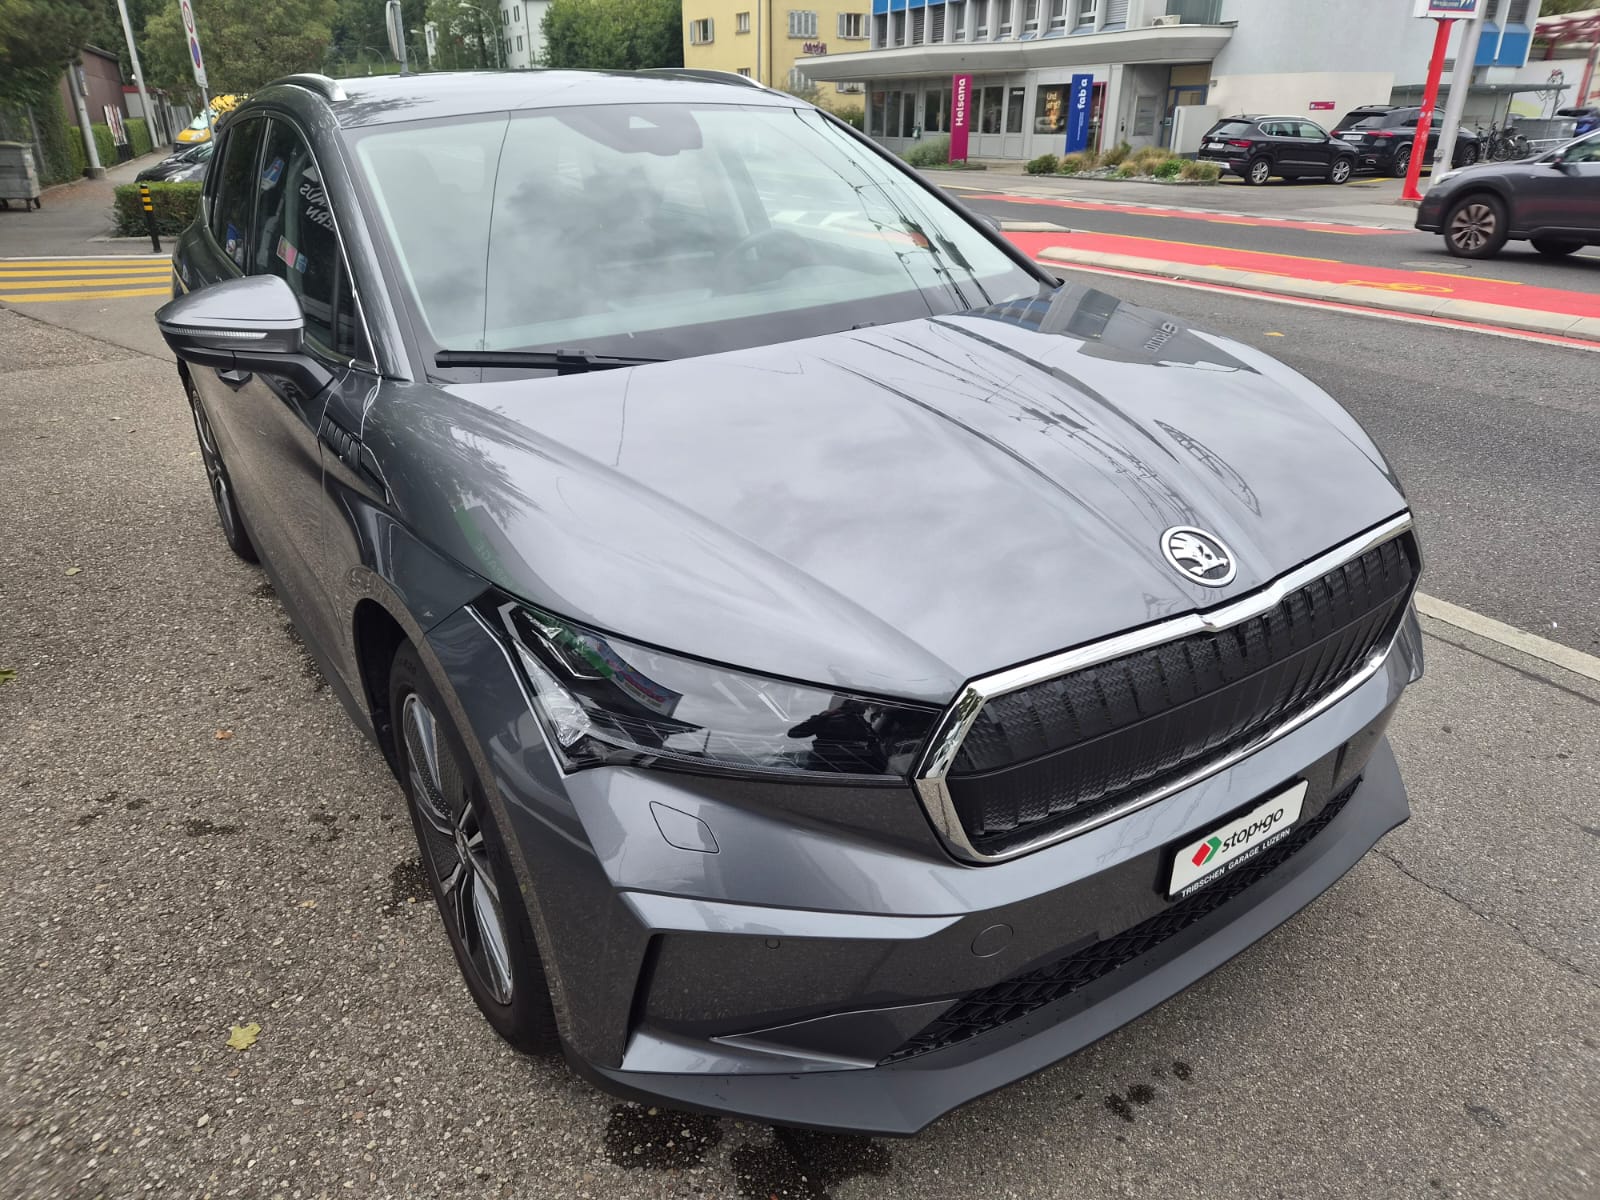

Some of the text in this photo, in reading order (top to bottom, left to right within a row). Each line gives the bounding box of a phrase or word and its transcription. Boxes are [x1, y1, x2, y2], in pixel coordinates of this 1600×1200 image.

[955, 78, 966, 126] Helsana
[1221, 808, 1284, 853] stop+go
[1180, 827, 1291, 898] TRIBSCHEN GARAGE LUZERN
